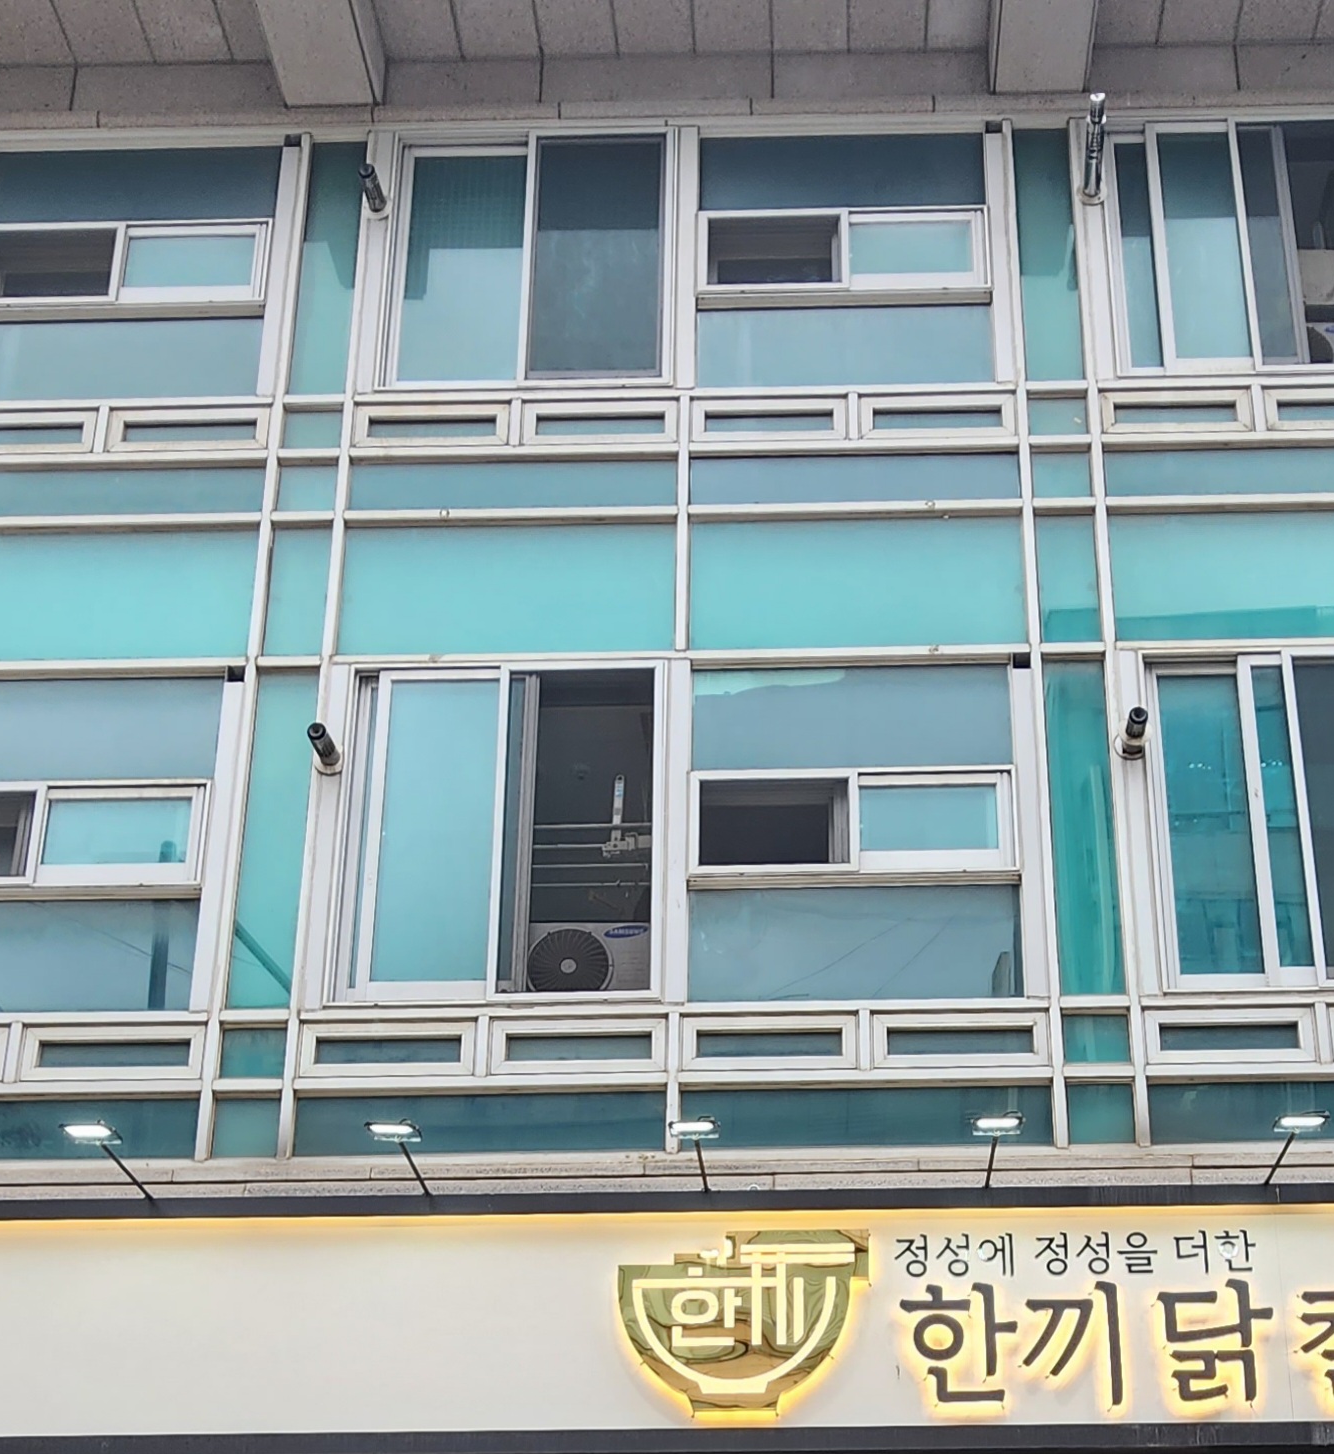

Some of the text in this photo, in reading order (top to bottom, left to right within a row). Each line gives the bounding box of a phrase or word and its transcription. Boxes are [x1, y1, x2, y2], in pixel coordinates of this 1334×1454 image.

[894, 1230, 1256, 1278] 정성에 정성을 더한
[900, 1281, 1124, 1405] 한끼
[1156, 1278, 1274, 1401] 닭
